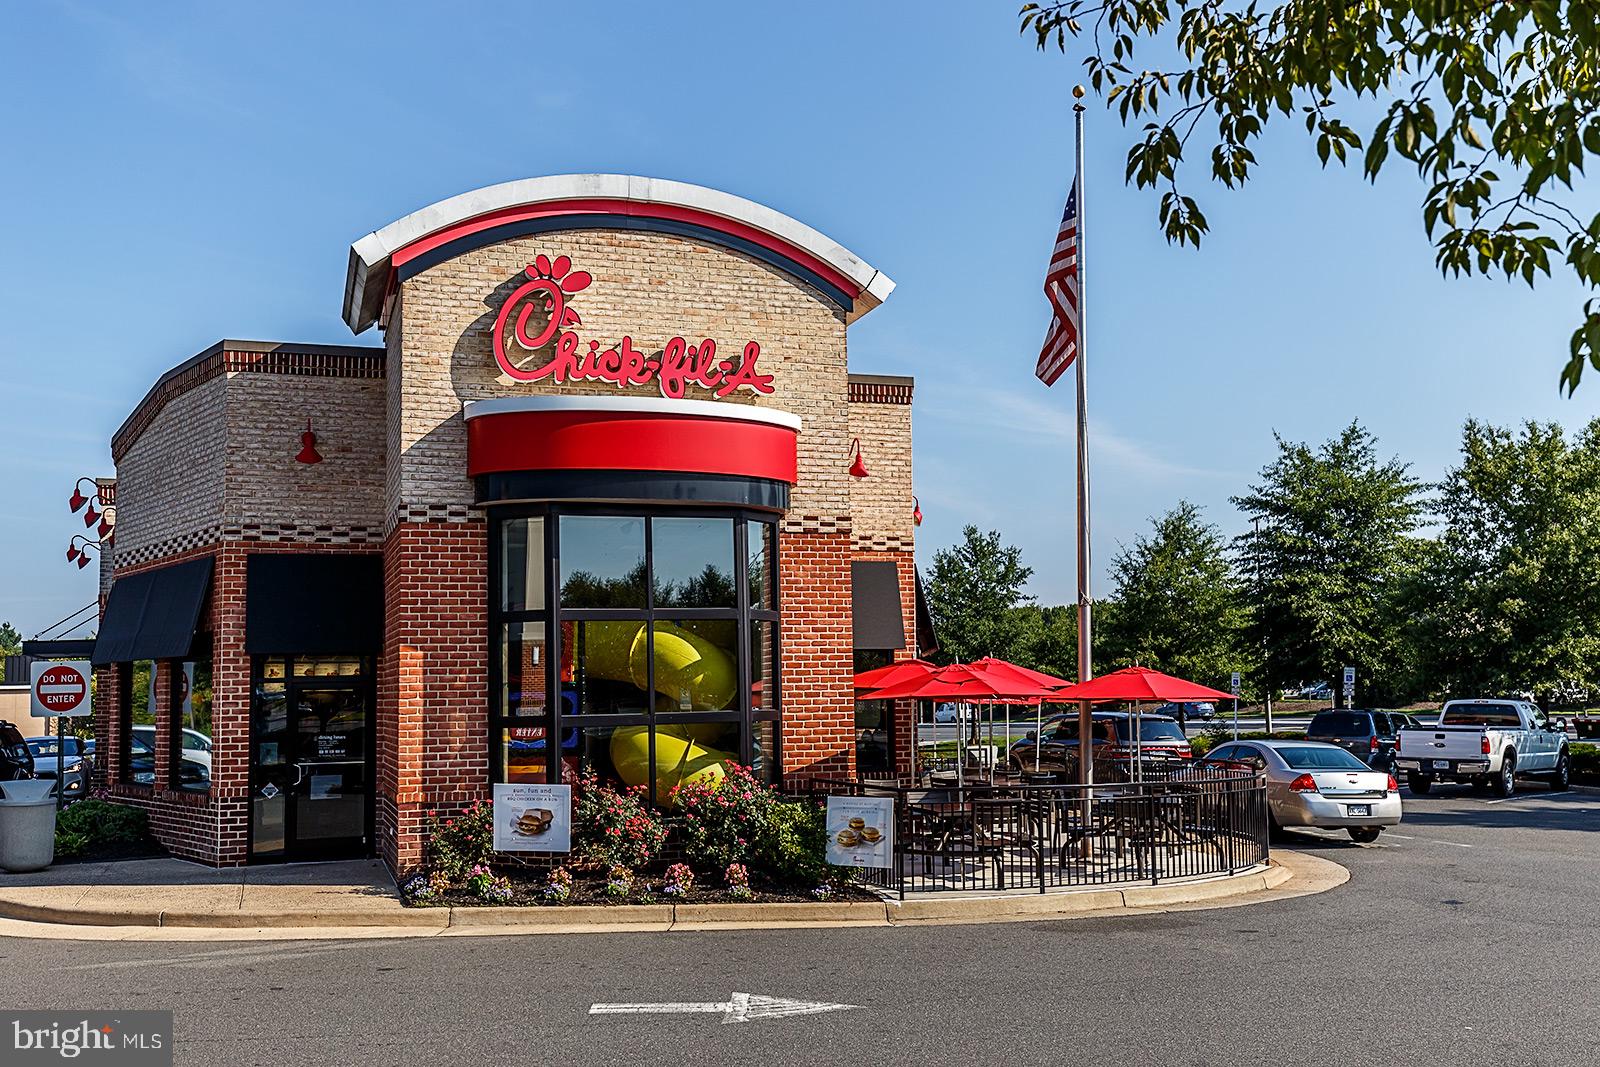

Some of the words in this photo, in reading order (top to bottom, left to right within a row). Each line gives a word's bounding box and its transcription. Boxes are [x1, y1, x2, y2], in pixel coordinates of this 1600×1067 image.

[493, 254, 775, 400] Chick-fil-A
[43, 675, 55, 683] DO
[61, 674, 78, 683] NOT
[47, 695, 75, 703] ENTER
